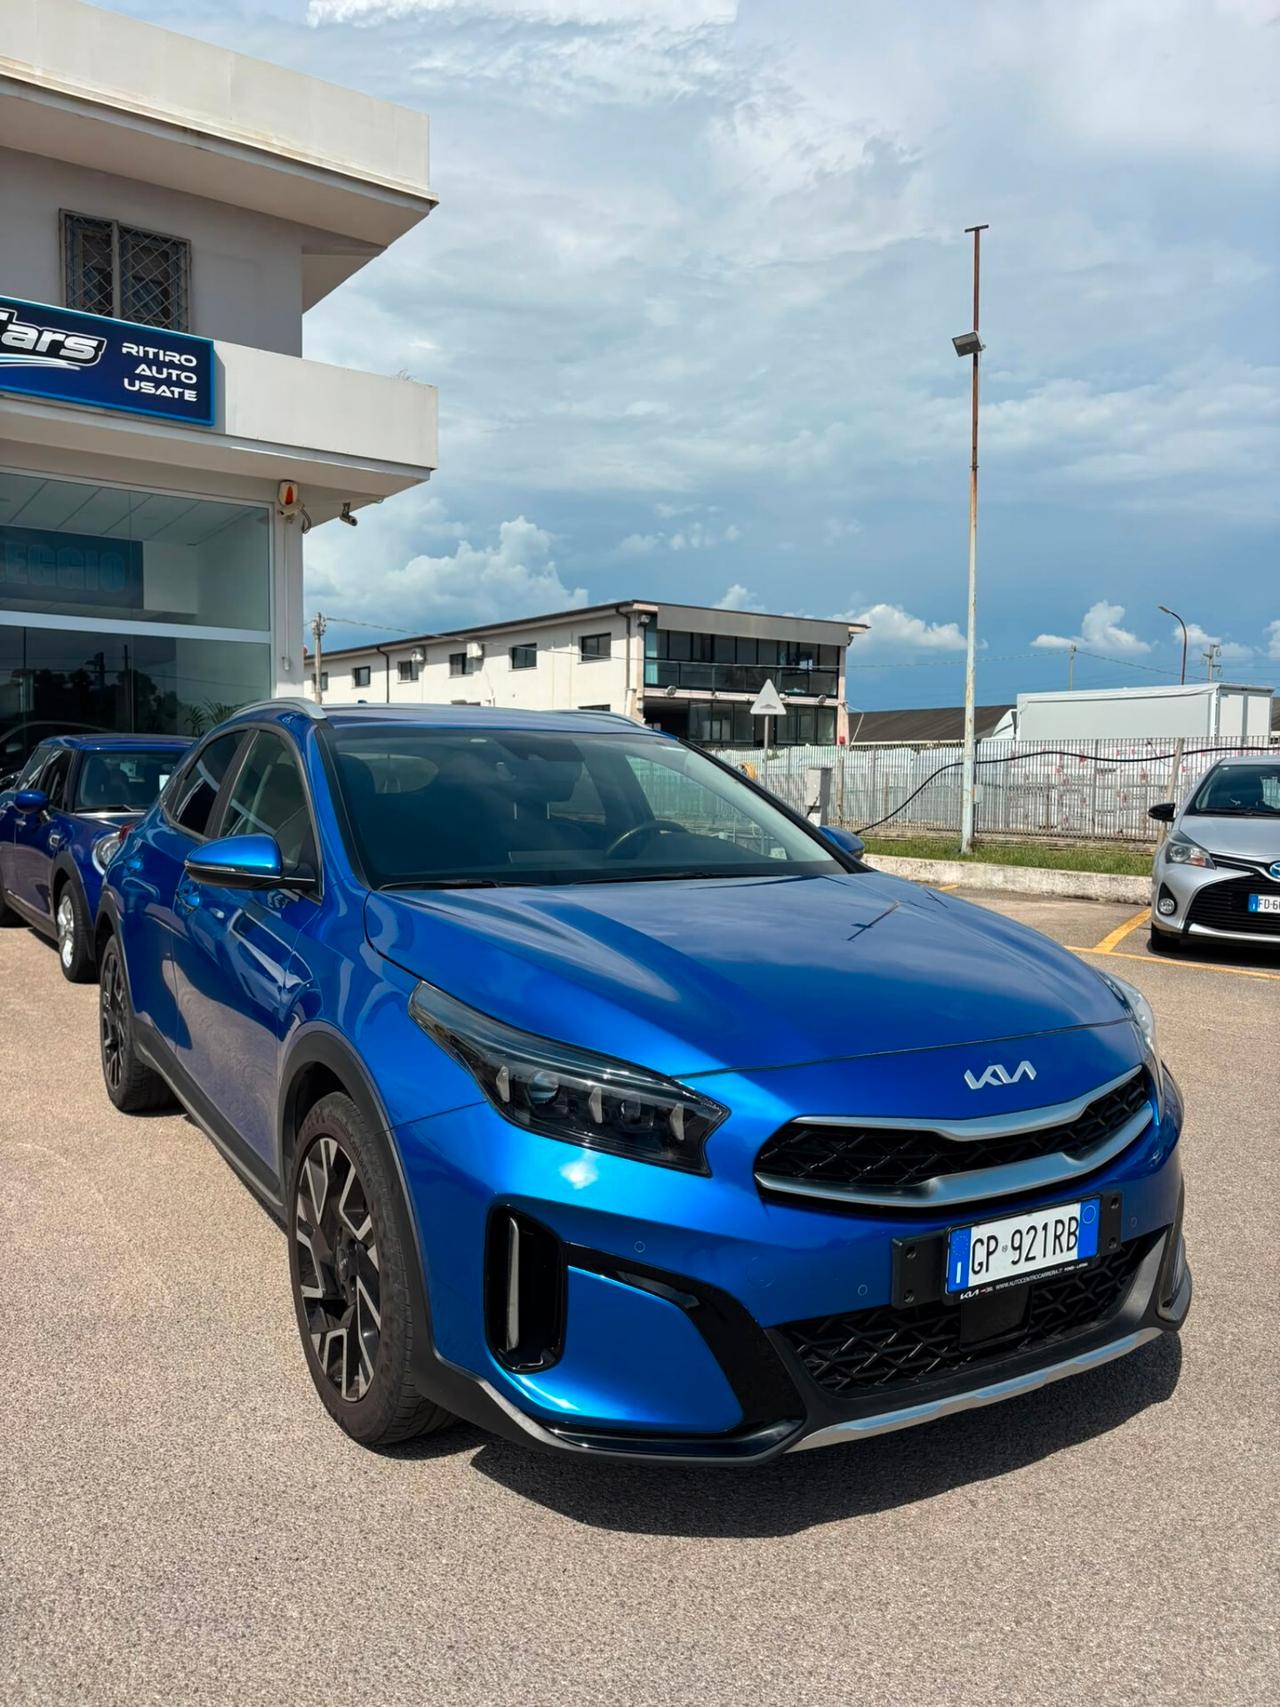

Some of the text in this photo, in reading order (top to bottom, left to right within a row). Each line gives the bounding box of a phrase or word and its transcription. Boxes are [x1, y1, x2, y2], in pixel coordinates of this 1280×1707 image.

[0, 310, 101, 361] ars
[121, 343, 198, 367] RITIRO
[134, 363, 198, 384] AUTO
[123, 378, 198, 402] USATE
[964, 1060, 1037, 1090] KIA
[971, 1216, 1079, 1276] GP 921RB
